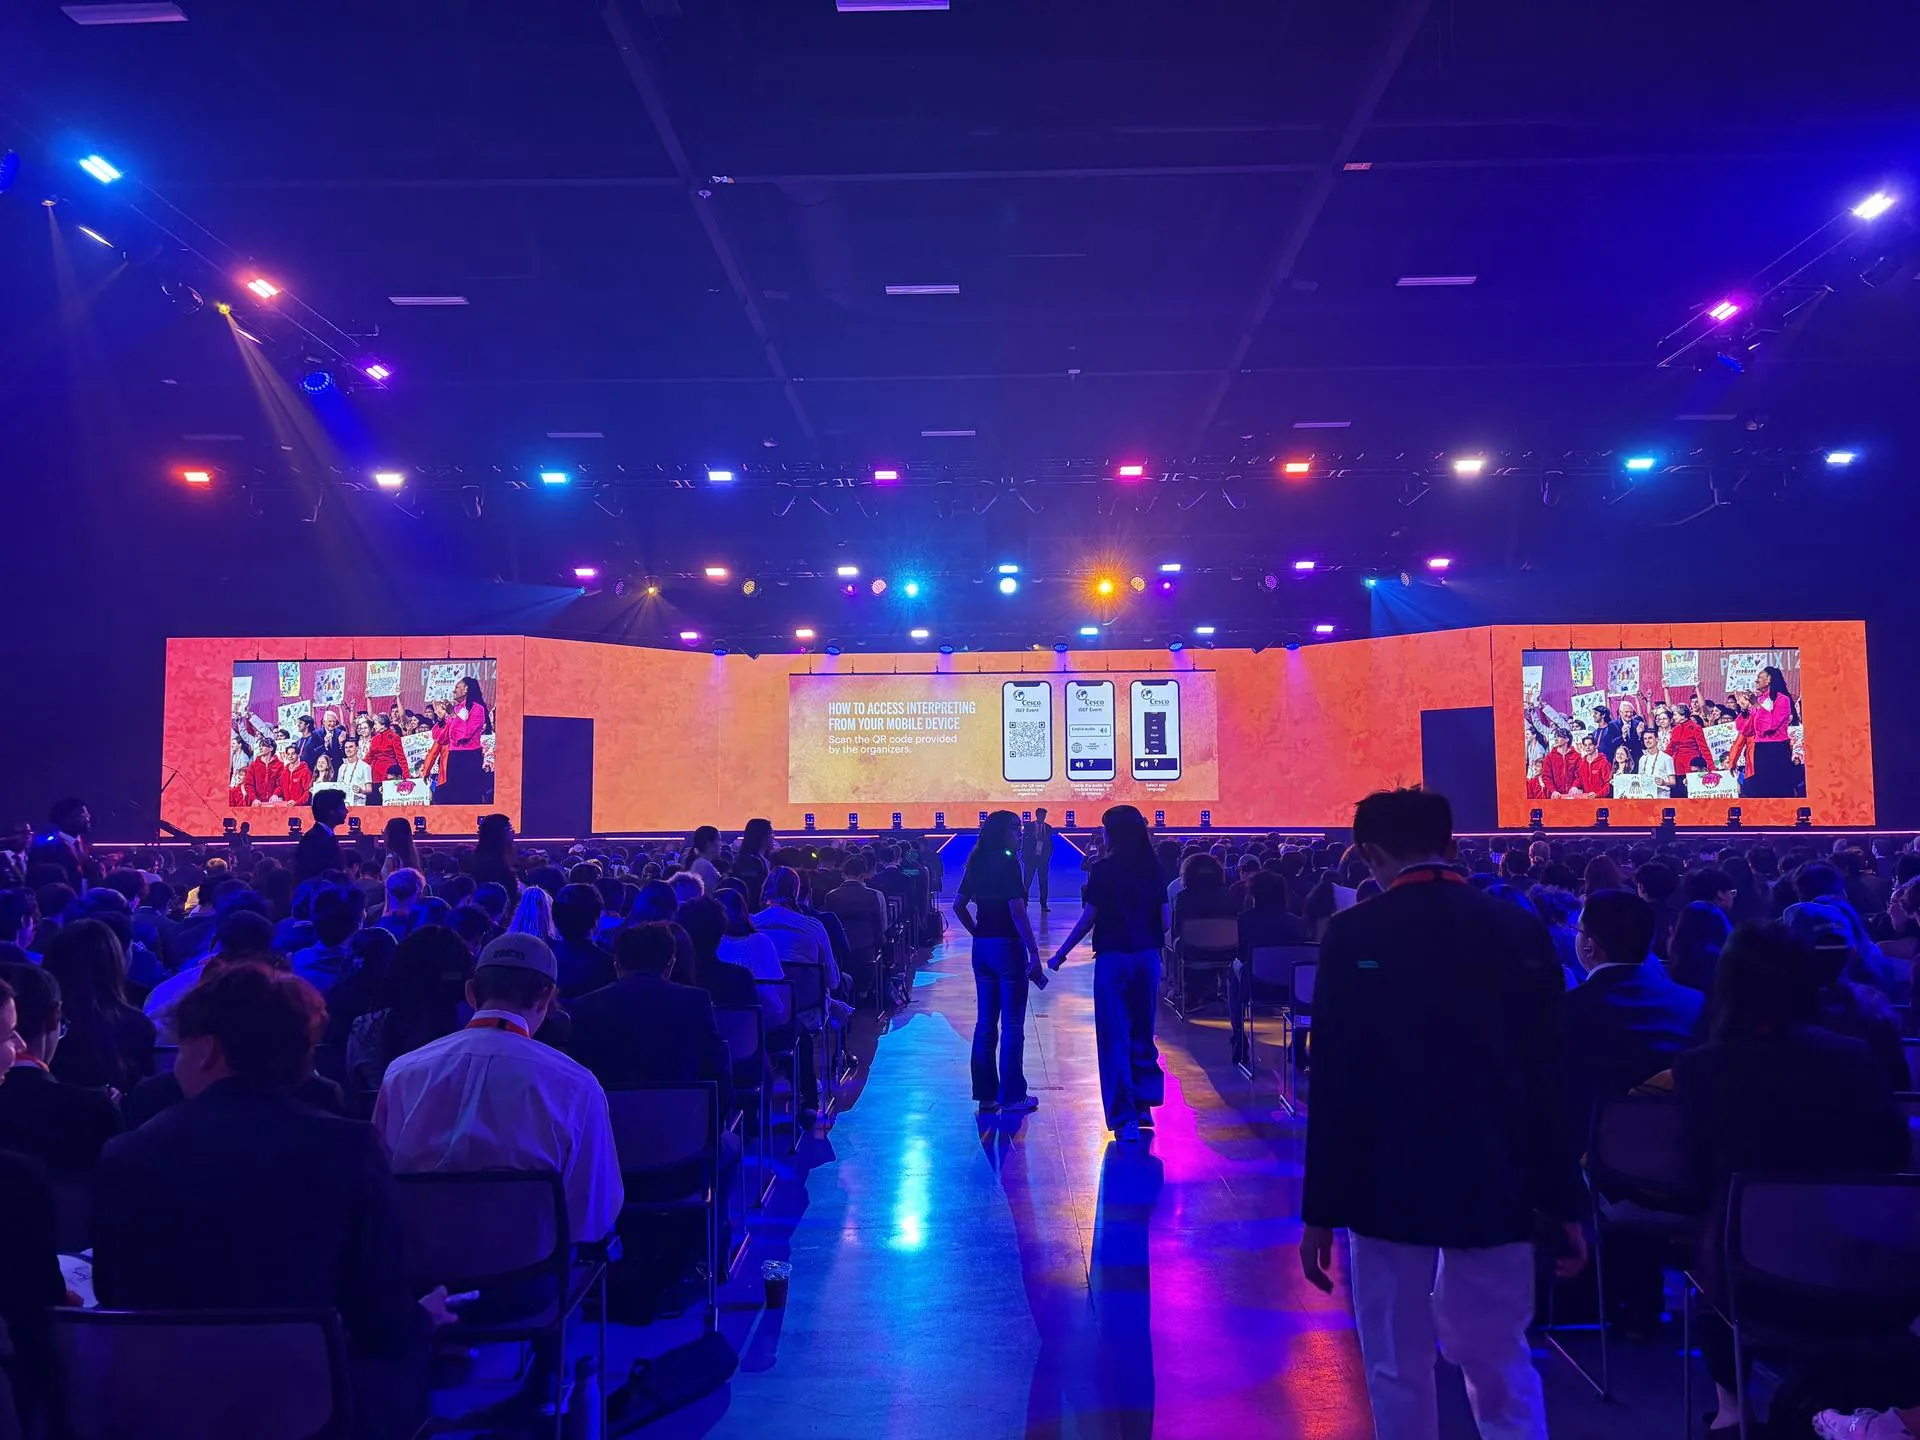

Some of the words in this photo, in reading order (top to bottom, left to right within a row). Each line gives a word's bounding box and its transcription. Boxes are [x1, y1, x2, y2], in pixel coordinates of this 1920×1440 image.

[828, 703, 850, 715] HOW
[853, 702, 865, 714] TO
[867, 702, 905, 714] ACCESS
[907, 702, 976, 714] INTERPRETING
[828, 718, 856, 731] FROM
[858, 718, 884, 730] YOUR
[886, 718, 923, 730] MOBILE
[926, 717, 960, 730] DEVICE
[828, 735, 852, 744] Scan
[854, 735, 869, 744] the
[872, 735, 887, 744] QR
[889, 735, 913, 743] code
[915, 734, 957, 745] provided
[828, 746, 840, 755] by
[860, 746, 912, 755] organizers.
